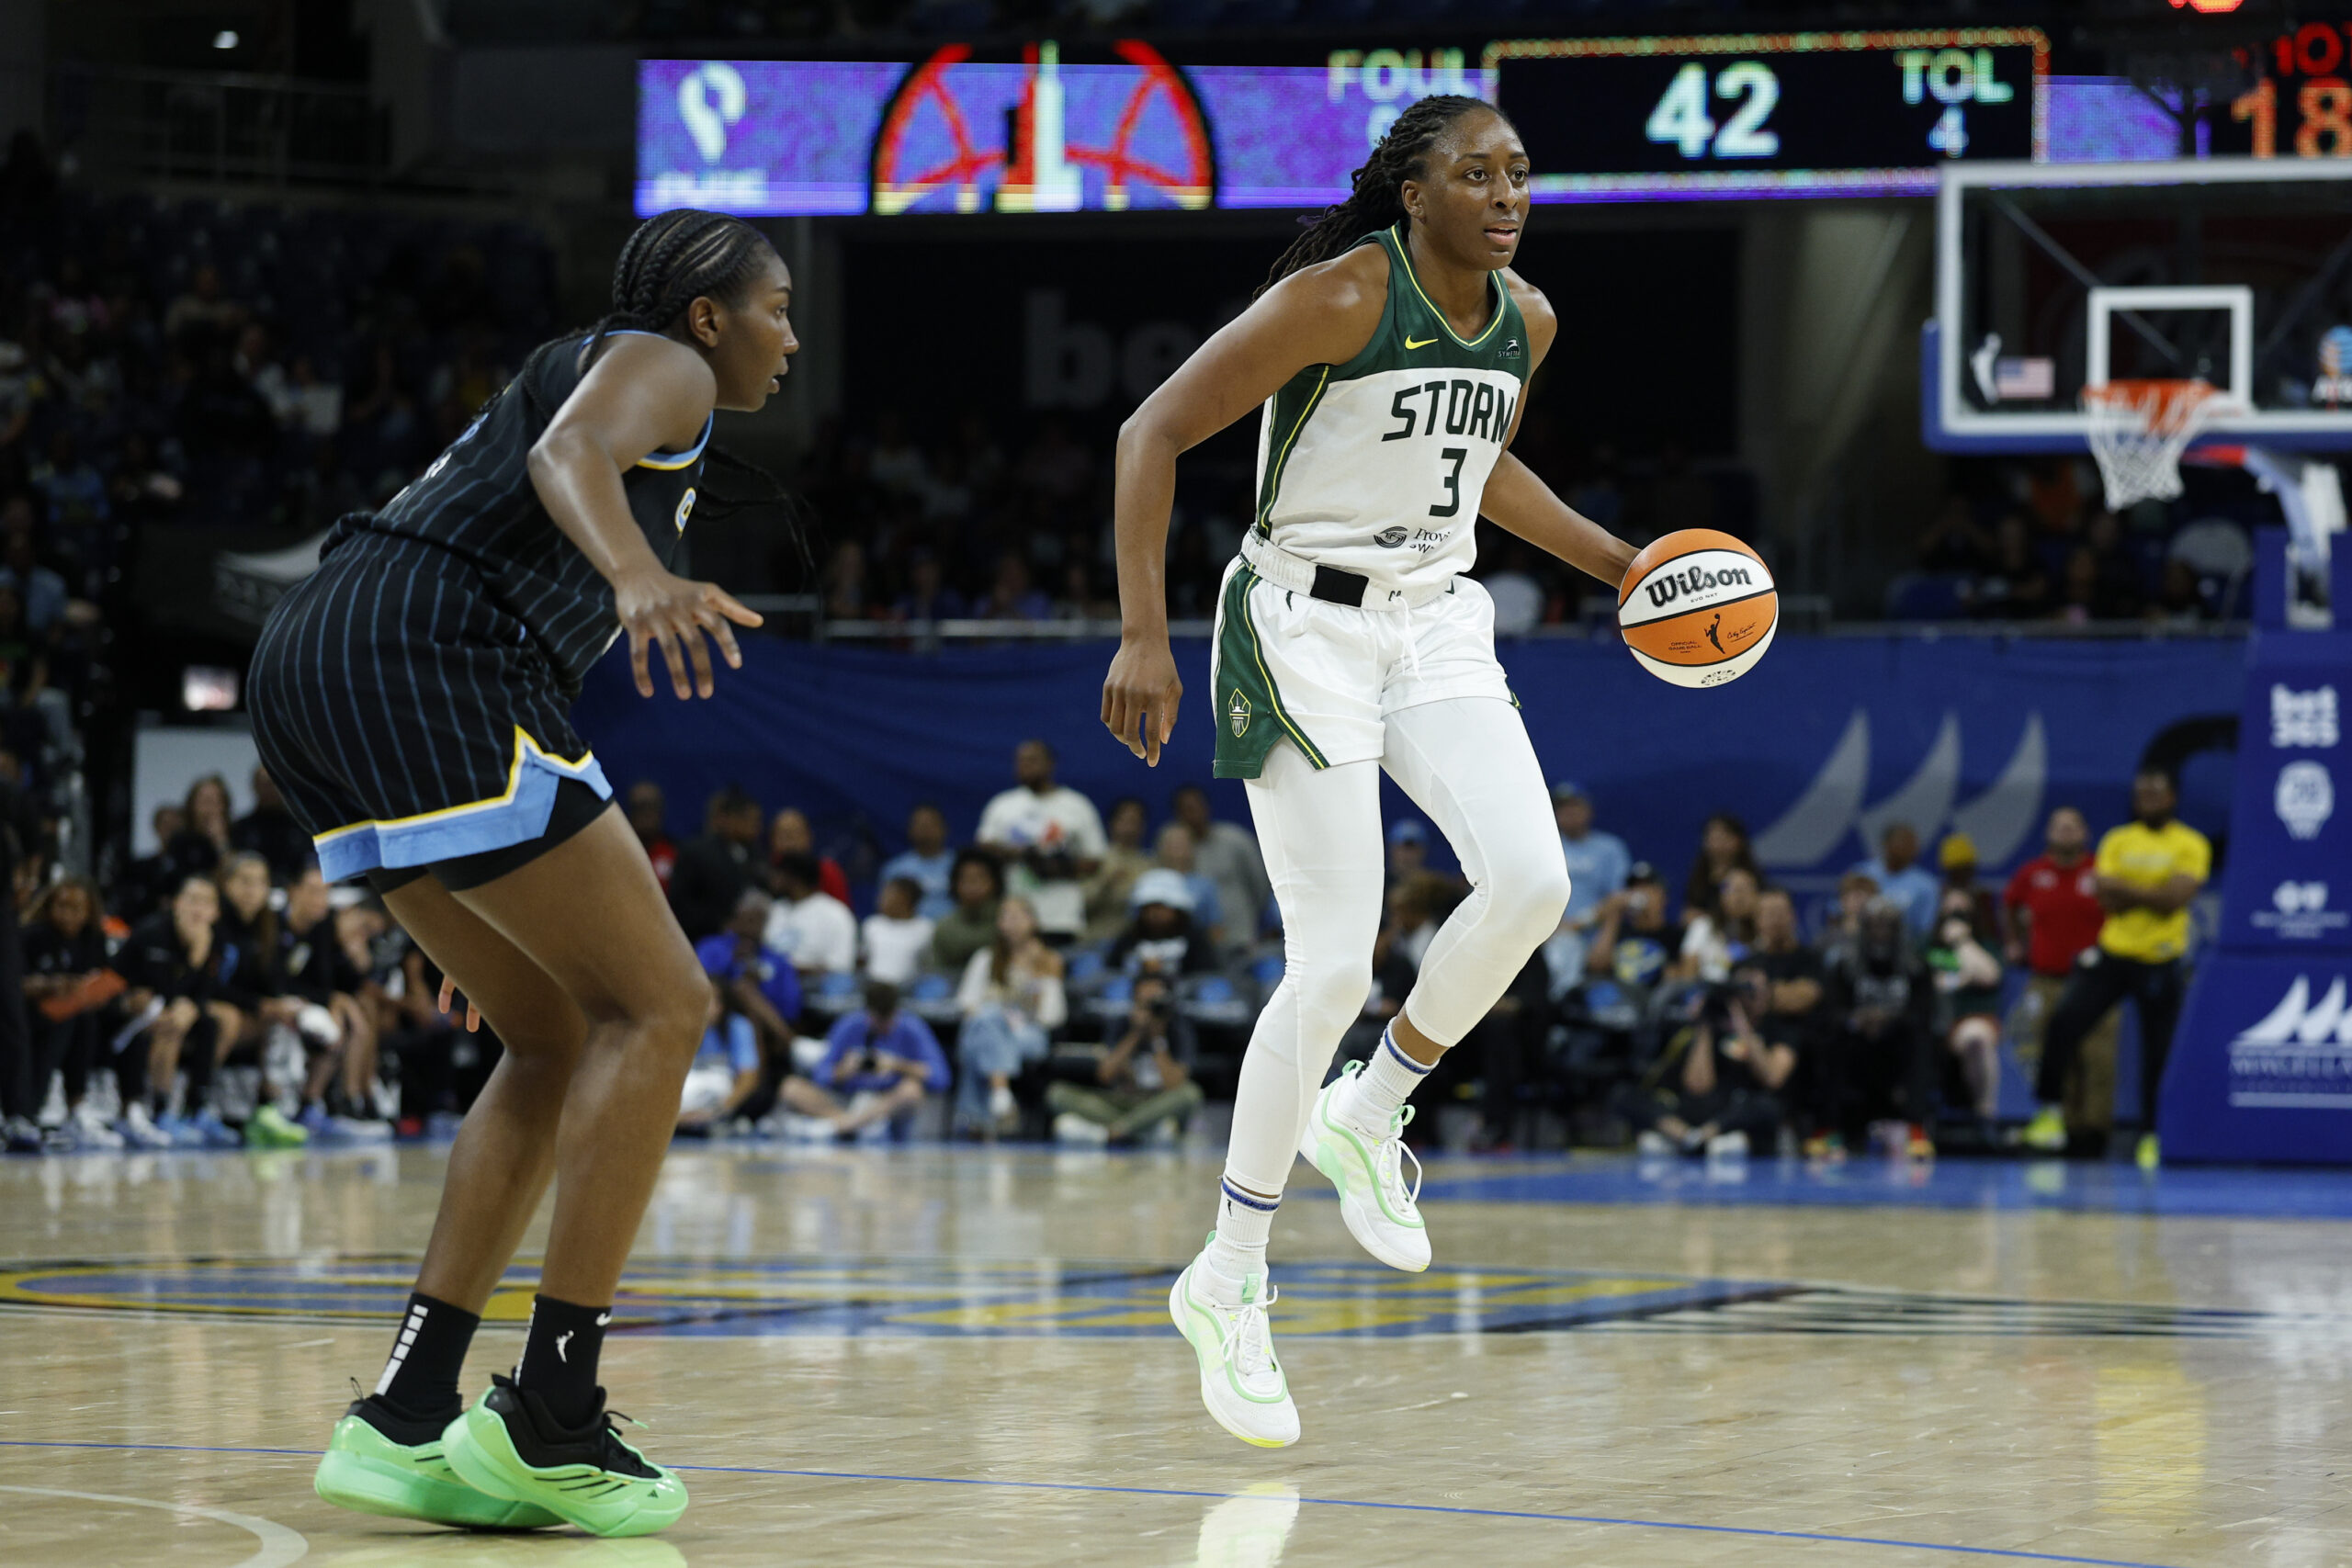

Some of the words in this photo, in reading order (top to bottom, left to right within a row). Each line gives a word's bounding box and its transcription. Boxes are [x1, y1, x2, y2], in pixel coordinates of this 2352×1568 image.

[1328, 48, 1480, 104] FOUL
[1893, 48, 2015, 105] TOL
[1645, 61, 1781, 159] 42
[1927, 105, 1970, 159] 4
[2231, 75, 2352, 159] 18
[1023, 288, 1251, 410] be
[1381, 378, 1515, 445] STORM
[1429, 447, 1467, 517] 3
[1645, 566, 1753, 608] Wilson
